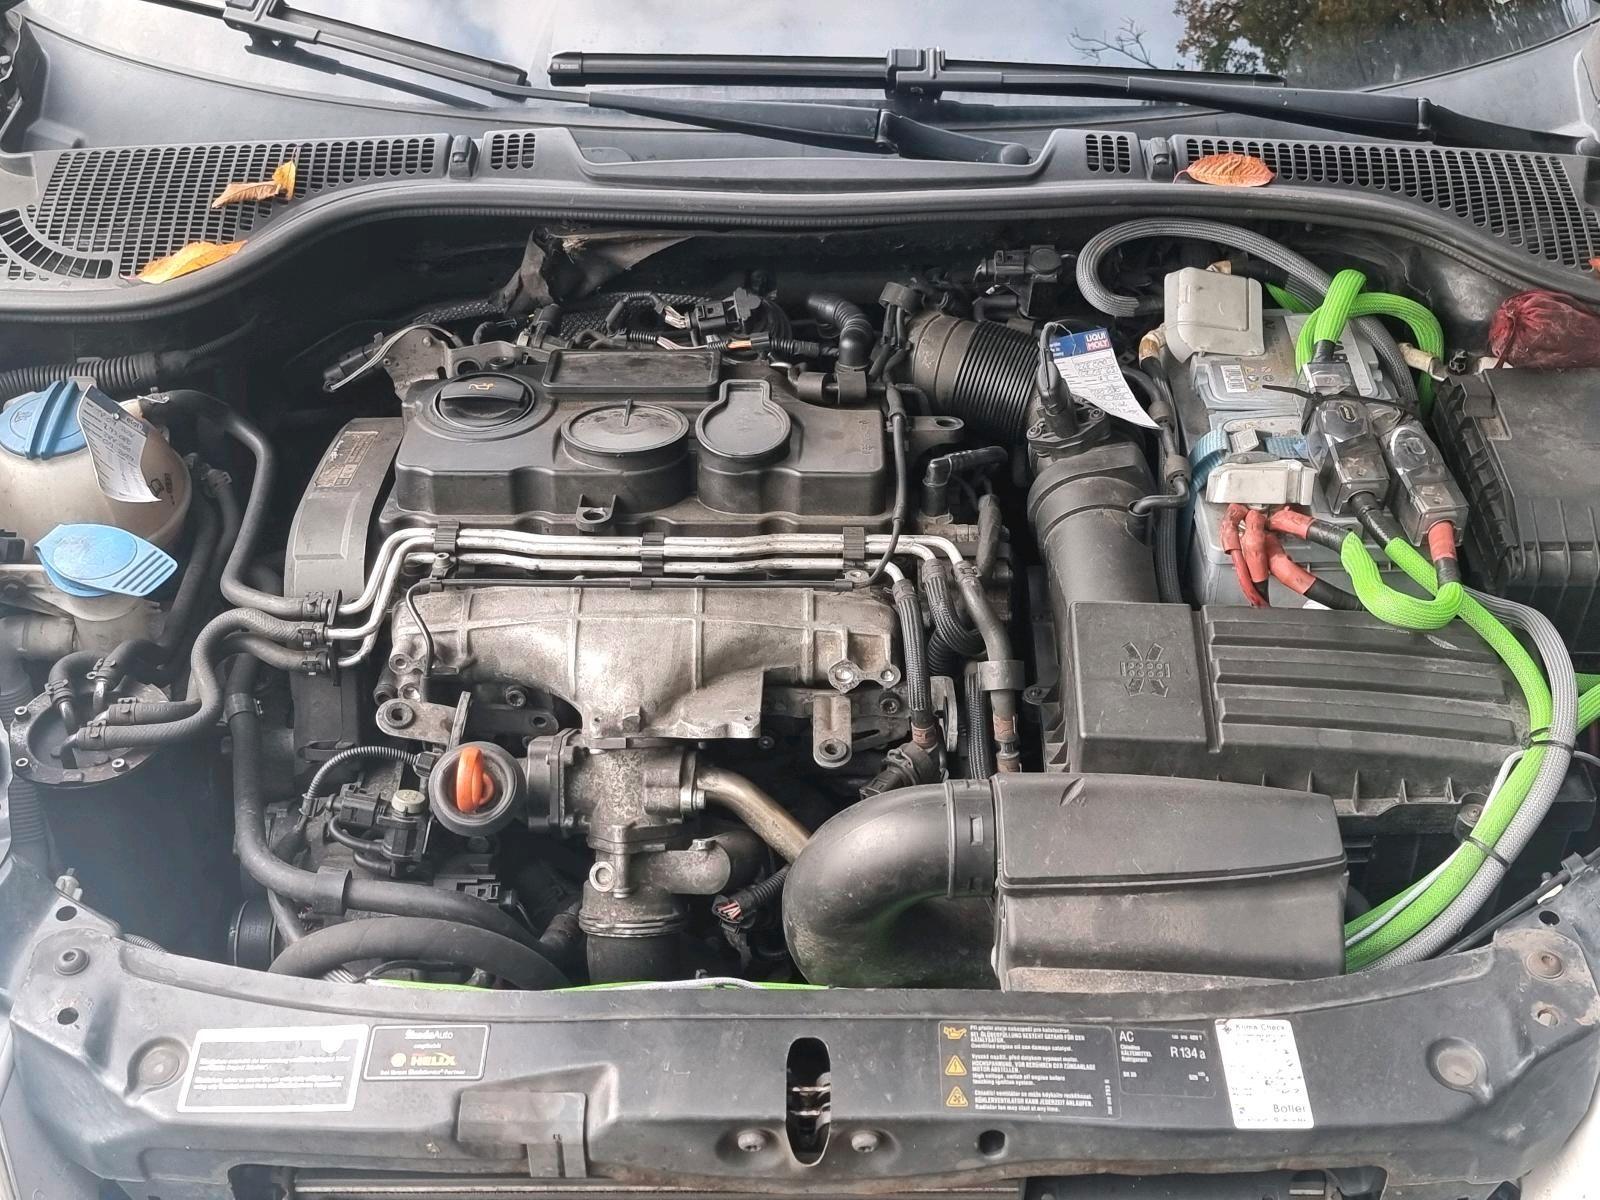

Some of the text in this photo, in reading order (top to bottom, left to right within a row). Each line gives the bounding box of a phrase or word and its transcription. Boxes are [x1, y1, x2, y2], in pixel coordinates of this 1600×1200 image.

[1119, 1030, 1134, 1042] AC
[1170, 1046, 1207, 1060] R 134 a
